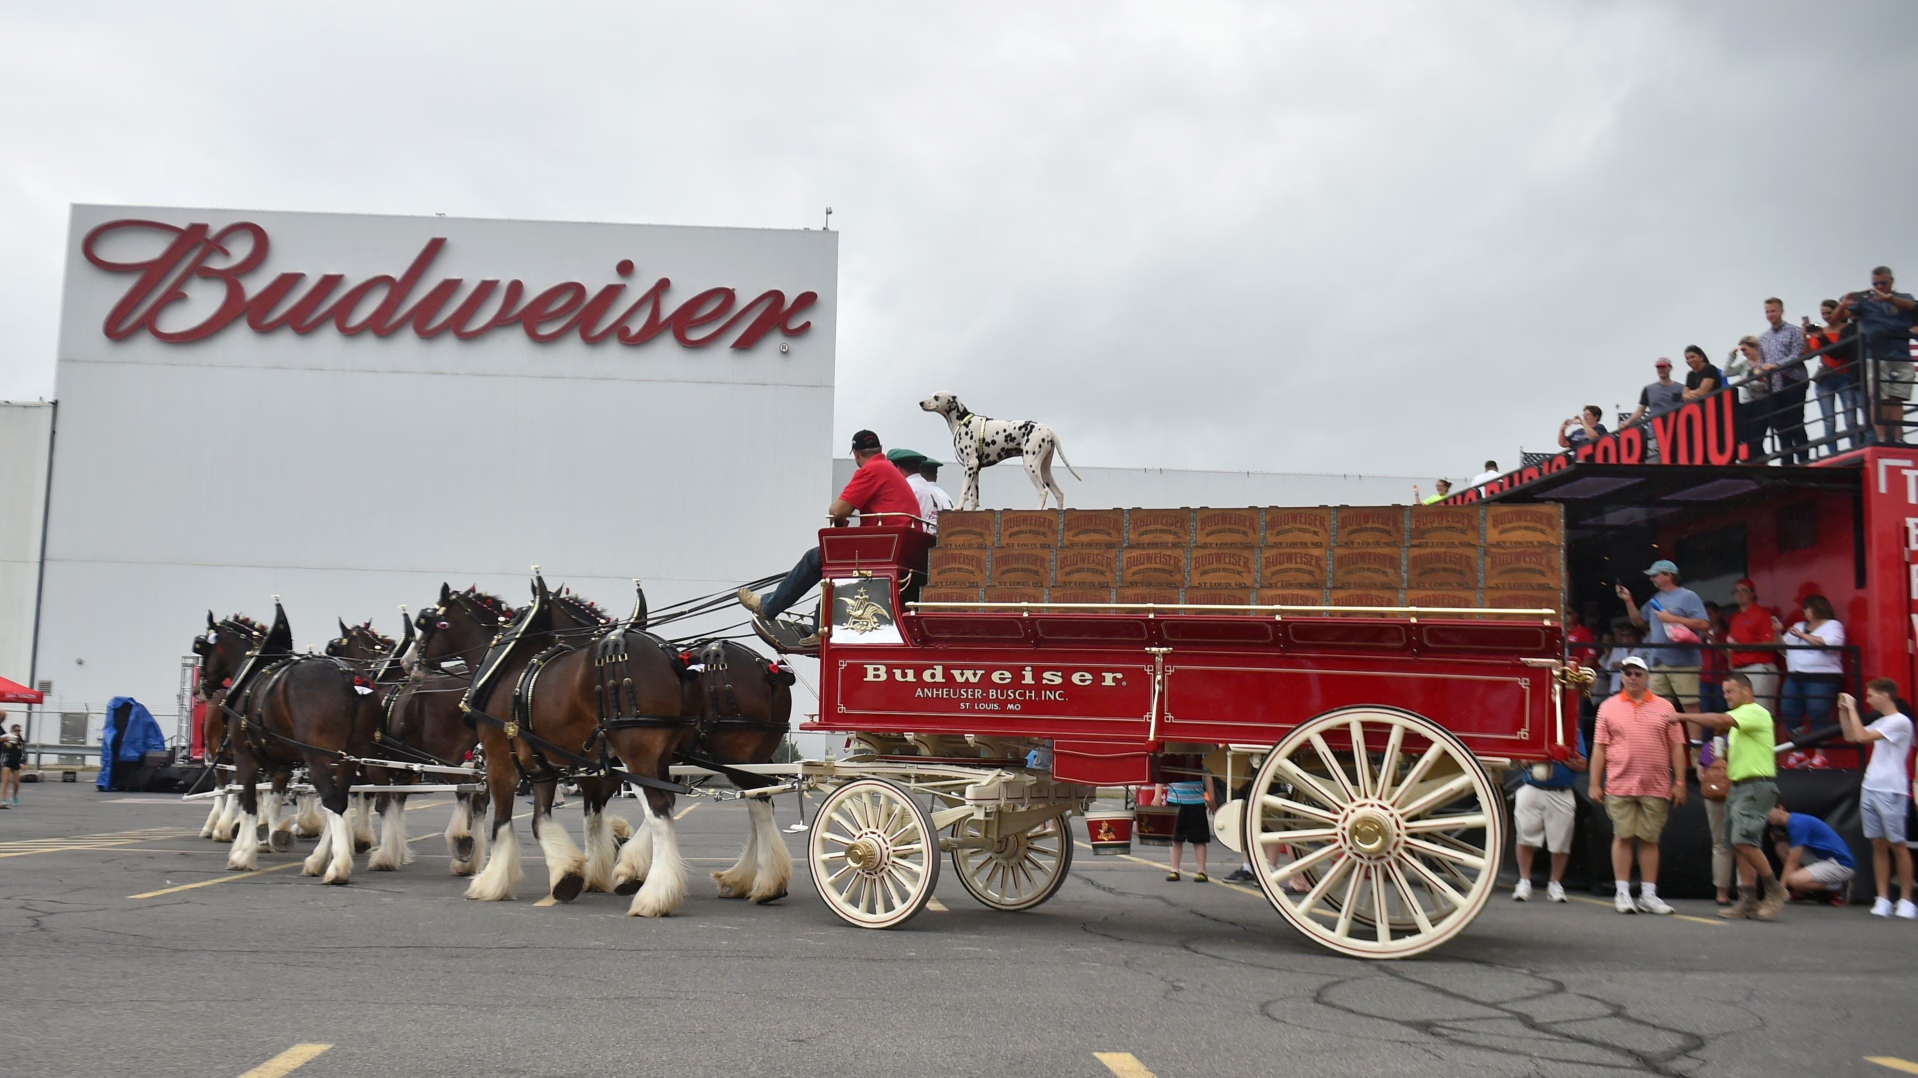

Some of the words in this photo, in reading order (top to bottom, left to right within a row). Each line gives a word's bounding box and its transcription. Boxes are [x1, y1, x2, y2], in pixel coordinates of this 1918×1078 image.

[82, 219, 817, 348] Budweiser
[1003, 515, 1056, 535] BUDWEISER
[1200, 512, 1256, 534] BUDWEISER
[1270, 512, 1328, 533] BUDWEISER
[932, 552, 983, 574] BUDWEISER
[995, 552, 1048, 574] BUDWEISER
[1060, 552, 1114, 574] BUDWEISER
[1126, 552, 1182, 574] BUDWEISER
[1194, 552, 1251, 574] BUDWEISER
[1264, 552, 1323, 573] BUDWEISER
[1041, 689, 1069, 701] INC.
[959, 702, 971, 710] ST.
[1006, 703, 1021, 711] MO
